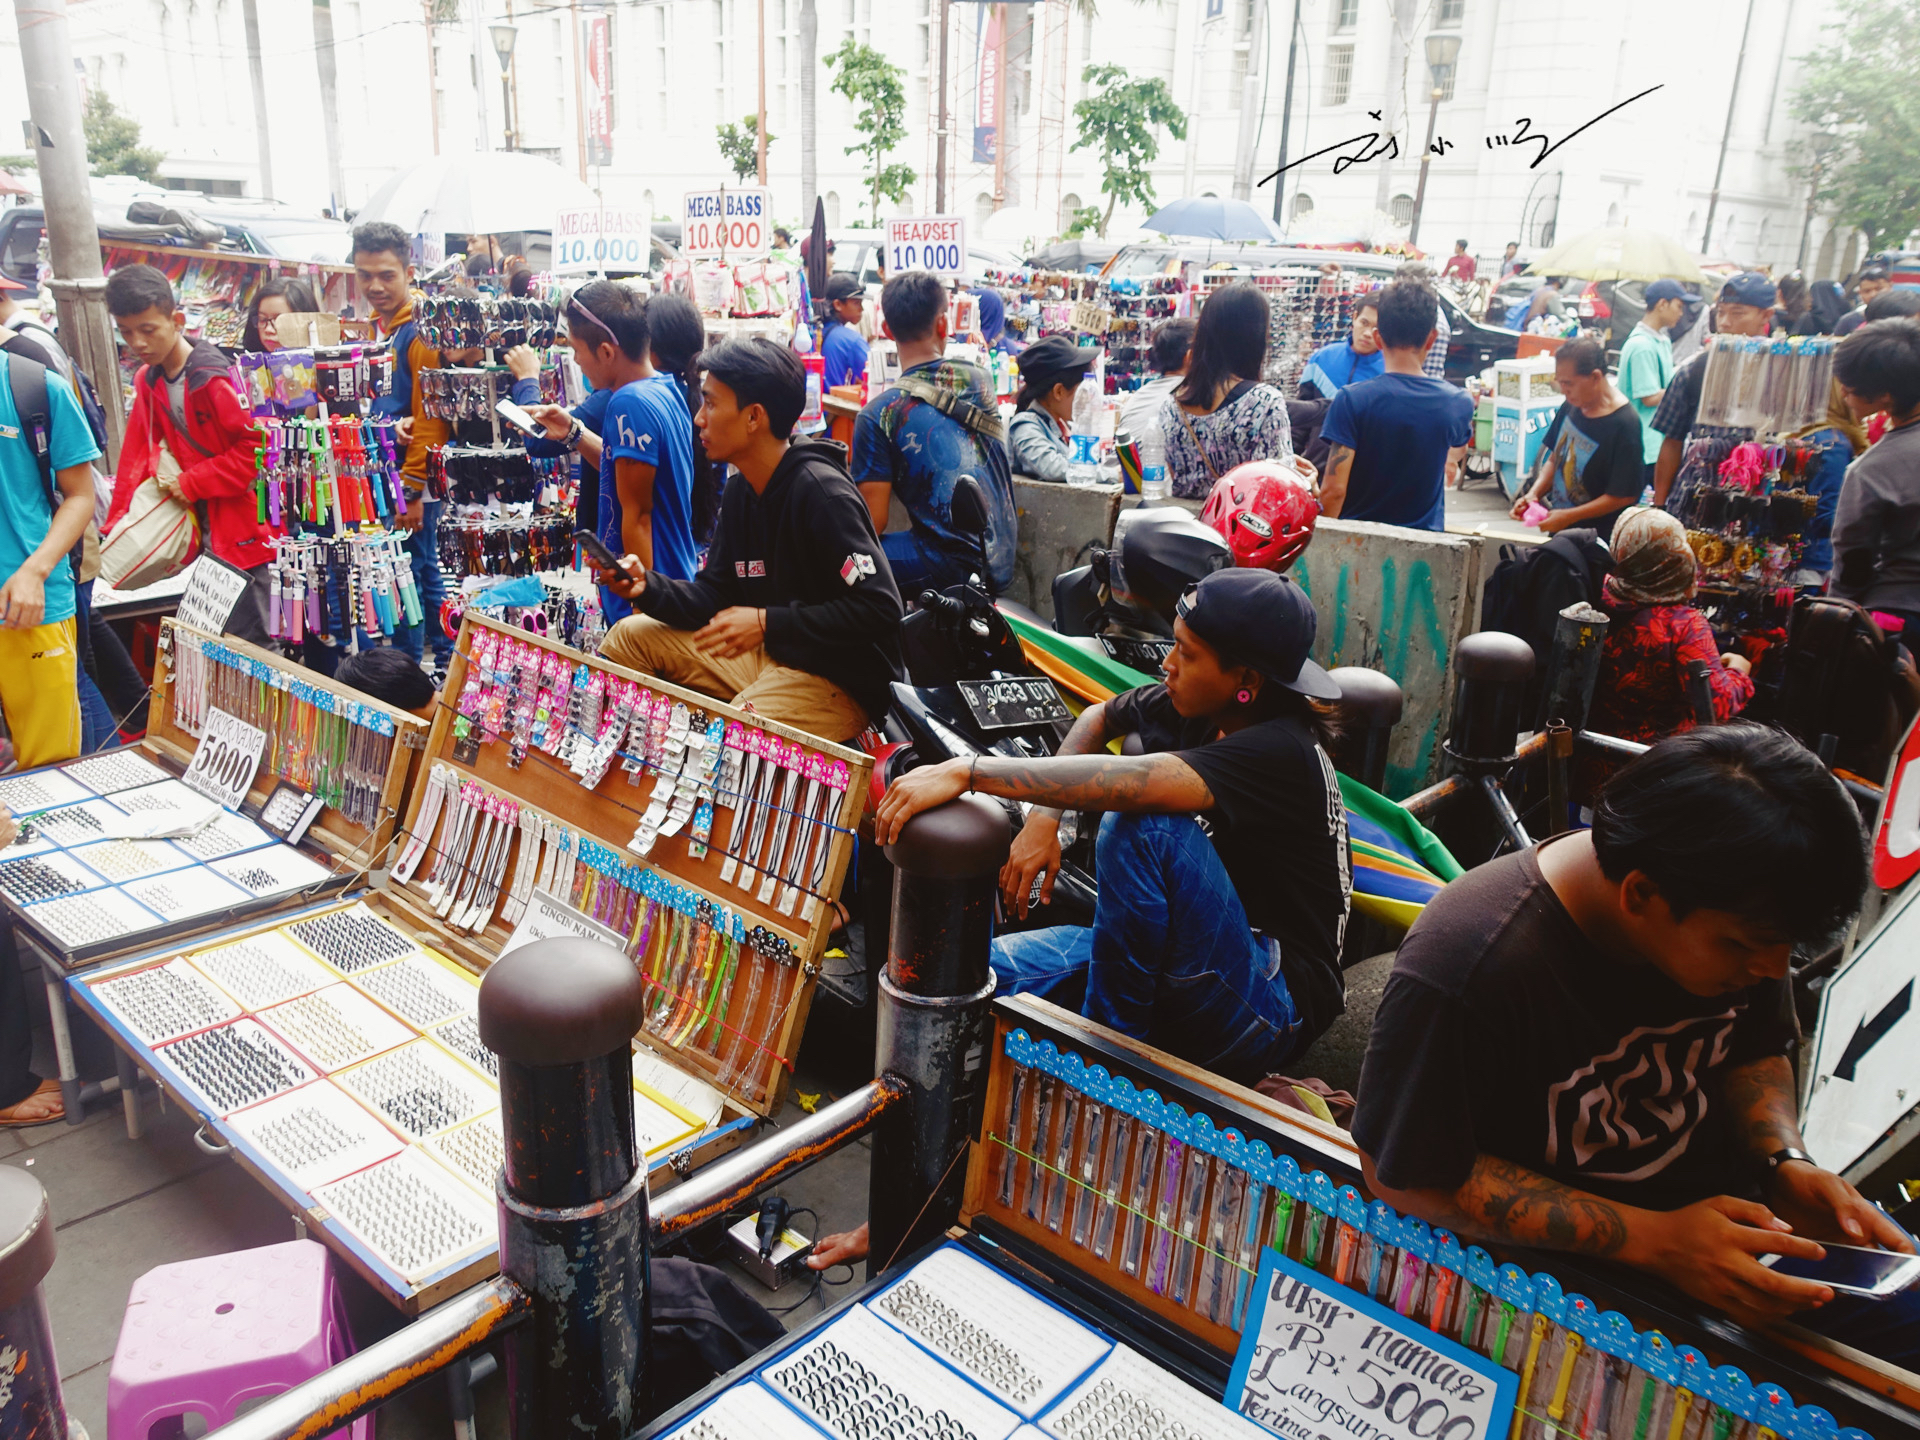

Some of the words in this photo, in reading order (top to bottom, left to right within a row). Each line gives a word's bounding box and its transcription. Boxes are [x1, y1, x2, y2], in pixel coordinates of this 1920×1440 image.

[982, 49, 996, 124] MUSEUM
[687, 196, 721, 218] MEGA
[726, 195, 761, 216] BASS
[558, 212, 599, 236] MEGA
[603, 212, 642, 235] BASS
[688, 221, 761, 250] 10.000
[893, 222, 958, 242] HEADSET
[558, 237, 640, 265] 10.000
[1102, 638, 1117, 655] B
[963, 686, 980, 707] B
[195, 734, 253, 793] 5000
[540, 904, 571, 929] CINCIN
[1347, 1359, 1476, 1440] 5000
